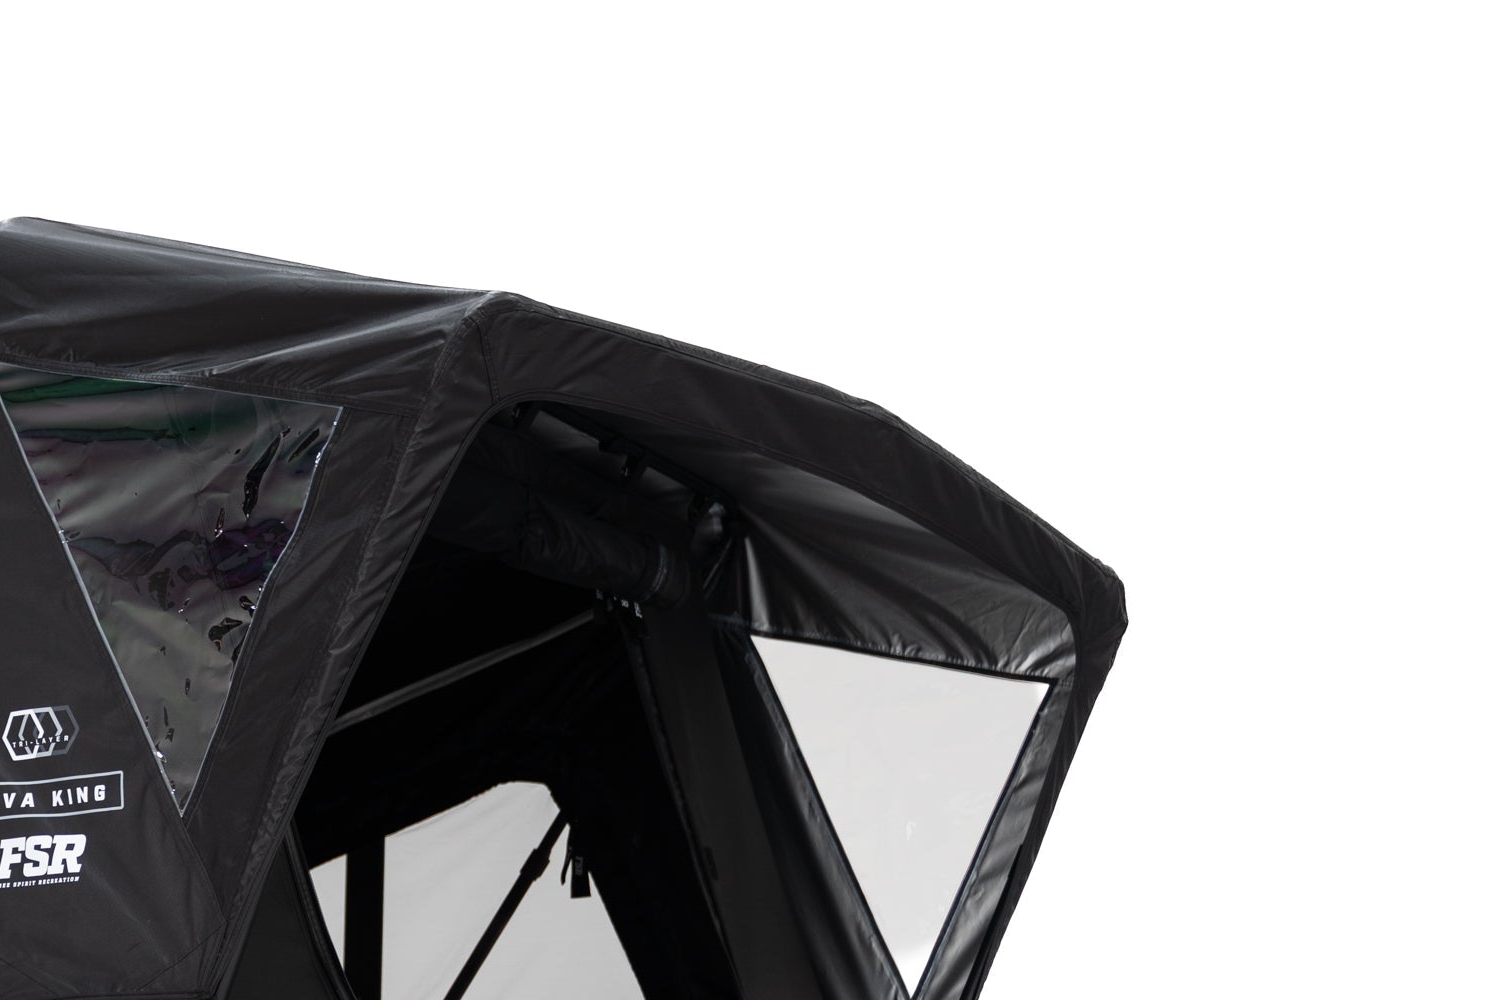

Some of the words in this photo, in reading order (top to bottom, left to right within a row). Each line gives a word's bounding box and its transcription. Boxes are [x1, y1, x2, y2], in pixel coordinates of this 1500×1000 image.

[12, 735, 69, 748] TRI-LAYER
[52, 784, 106, 807] KING
[13, 880, 36, 888] SPIRIT
[38, 876, 80, 886] RECREATION
